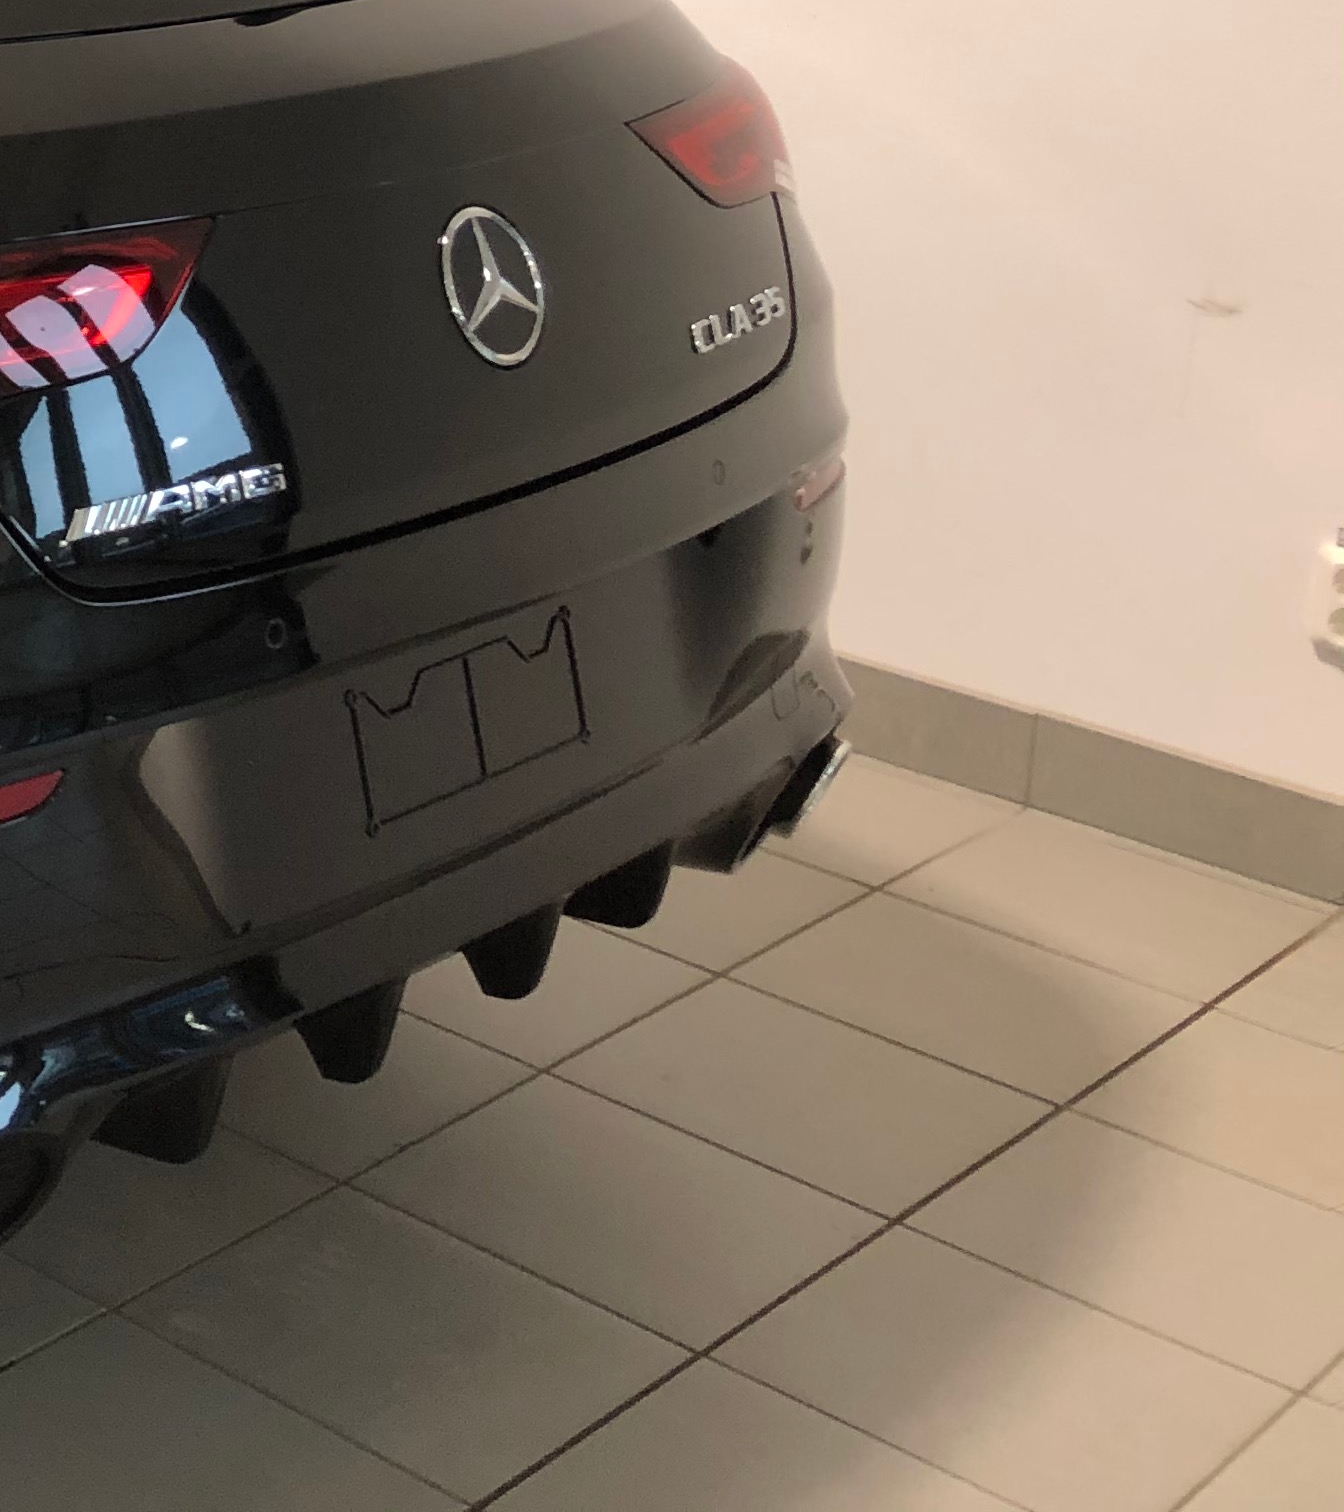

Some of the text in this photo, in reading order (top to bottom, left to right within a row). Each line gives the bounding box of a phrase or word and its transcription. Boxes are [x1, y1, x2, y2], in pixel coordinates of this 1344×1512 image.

[691, 286, 786, 354] CLA 35
[142, 463, 288, 524] AMG
